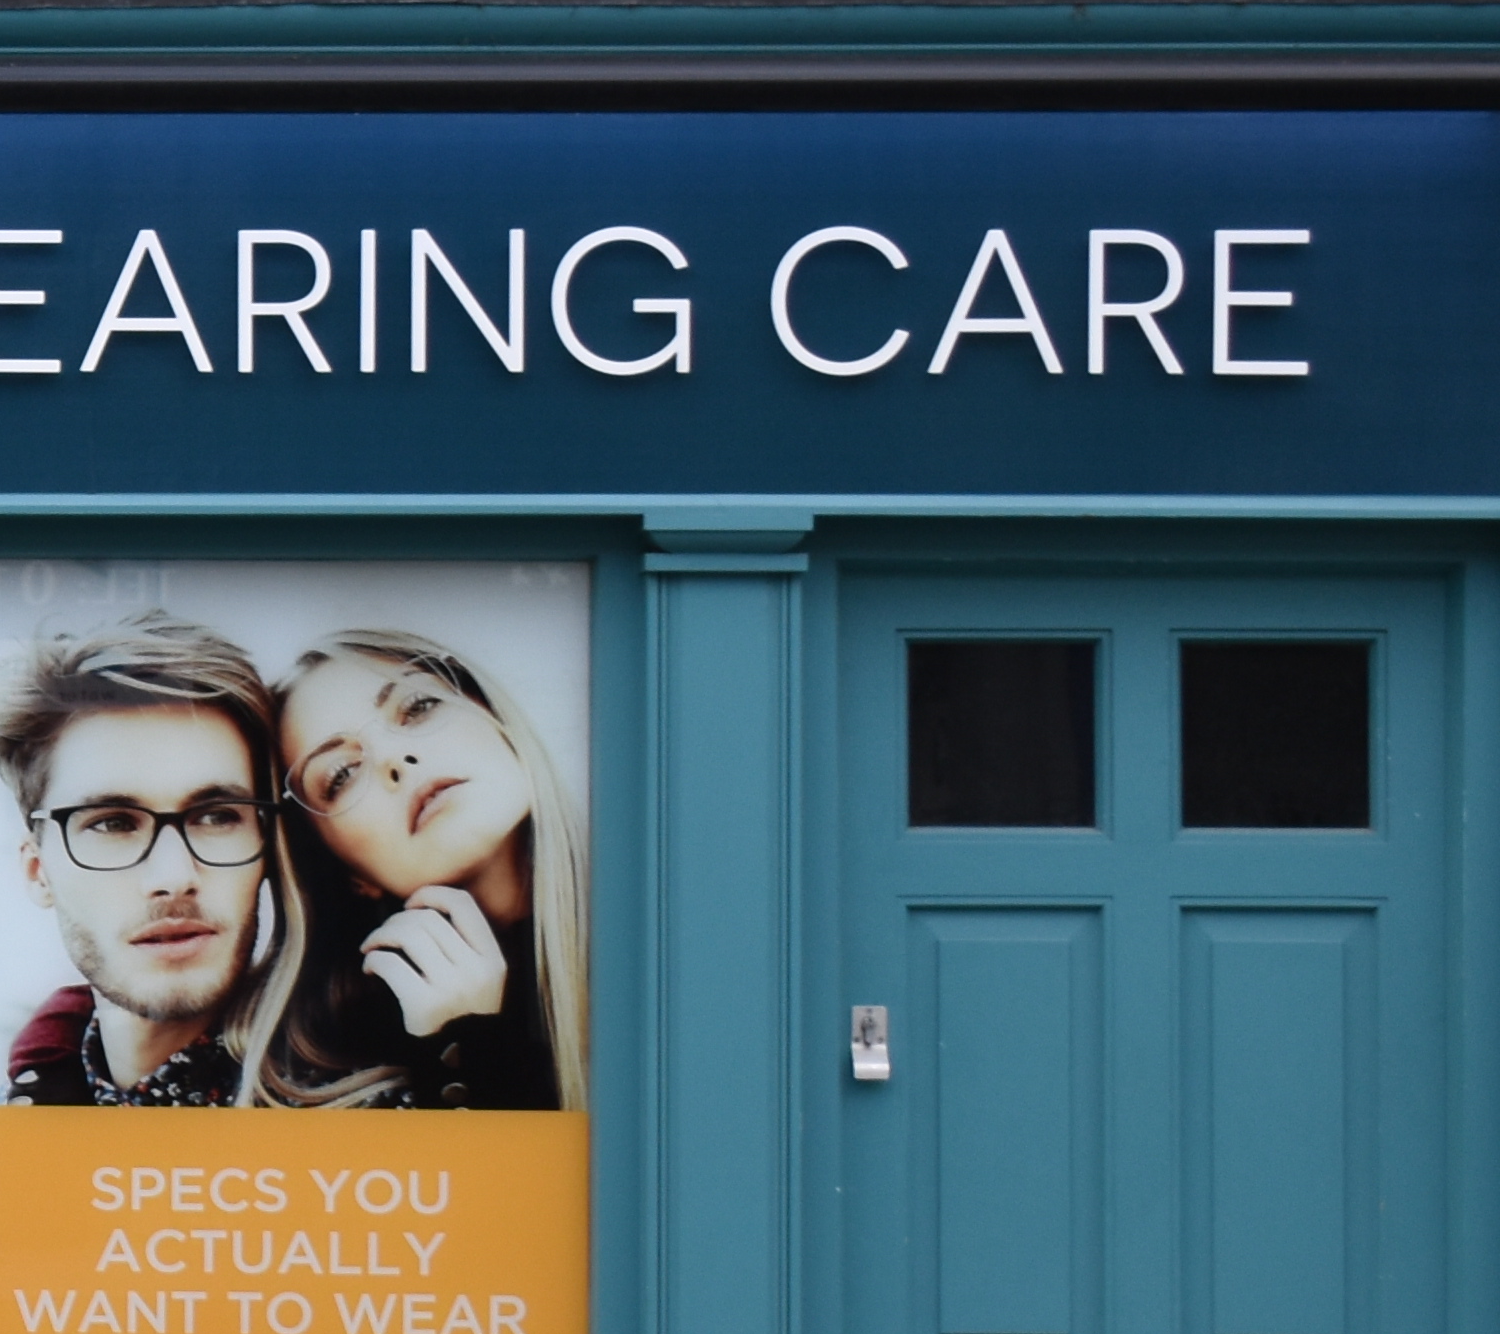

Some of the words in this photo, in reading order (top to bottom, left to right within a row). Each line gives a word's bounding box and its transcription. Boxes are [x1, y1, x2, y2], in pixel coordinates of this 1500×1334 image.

[769, 224, 1312, 377] CARE
[90, 1165, 289, 1213] SPECS
[308, 1168, 451, 1215] YOU
[94, 1228, 447, 1276] ACTUALLY
[13, 1288, 208, 1334] WANT
